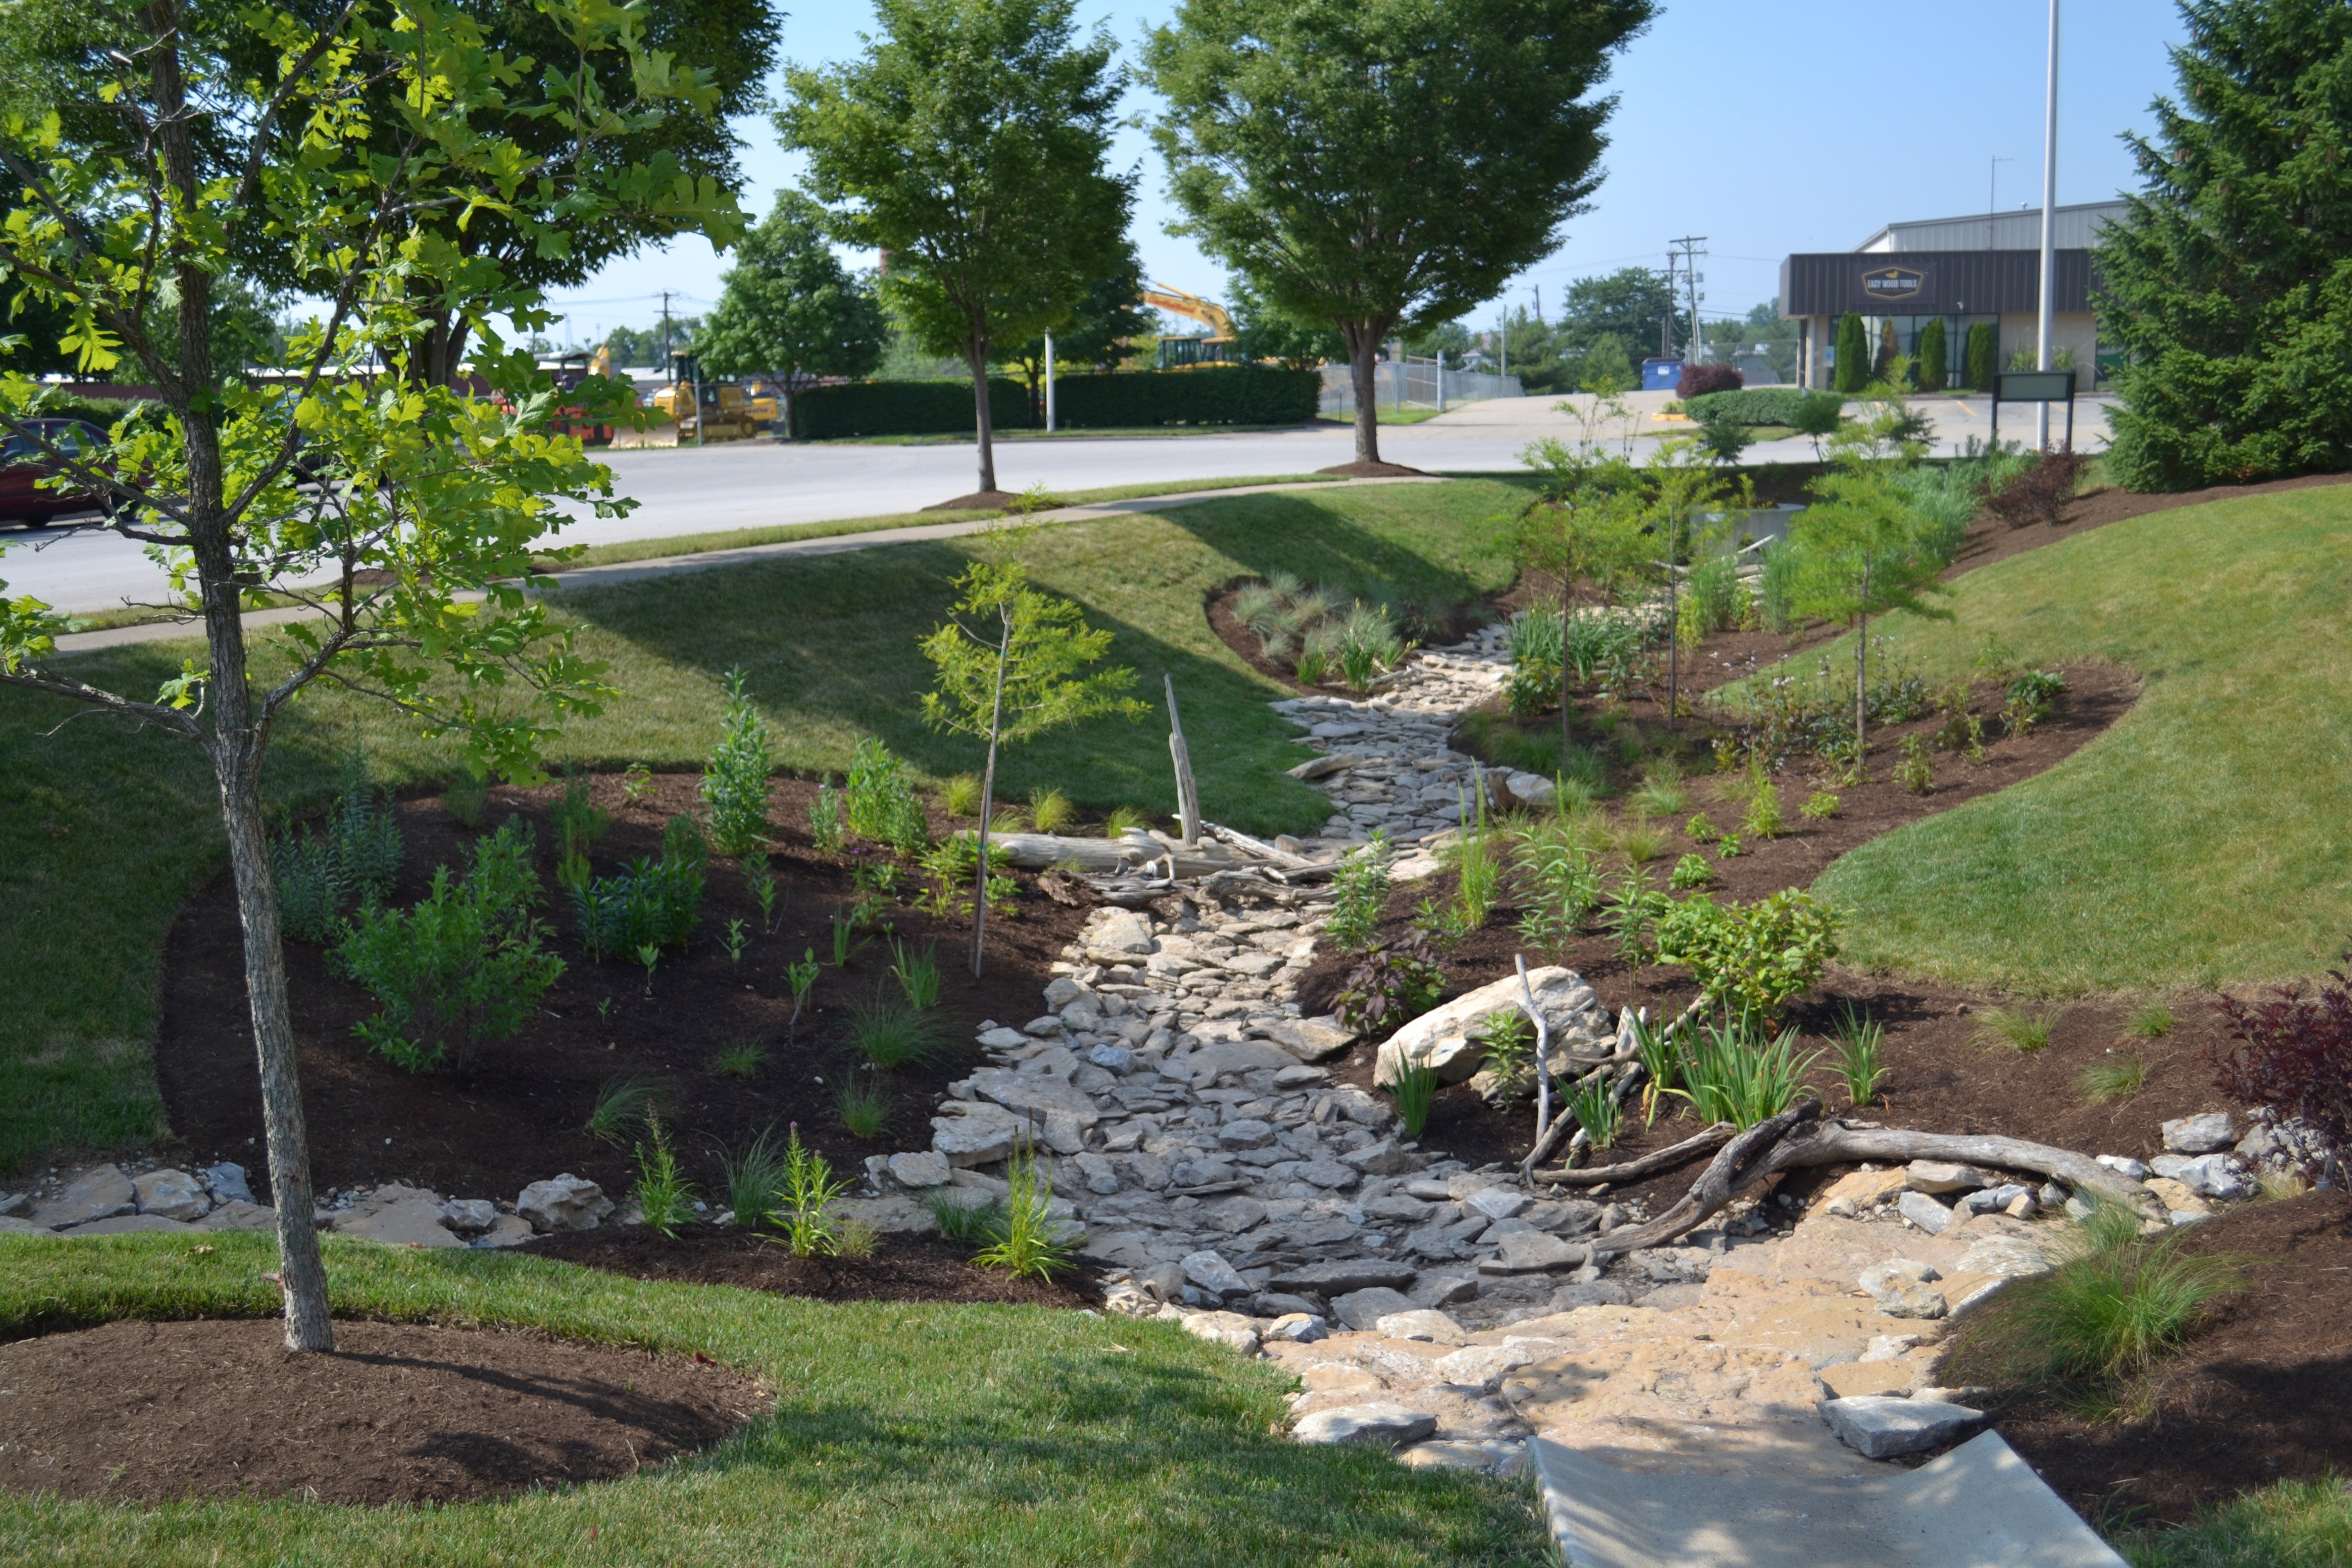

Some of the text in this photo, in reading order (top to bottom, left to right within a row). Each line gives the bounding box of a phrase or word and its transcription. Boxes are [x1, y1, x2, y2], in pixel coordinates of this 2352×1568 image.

[1867, 279, 1917, 288] EASY WOOD TOOLS
